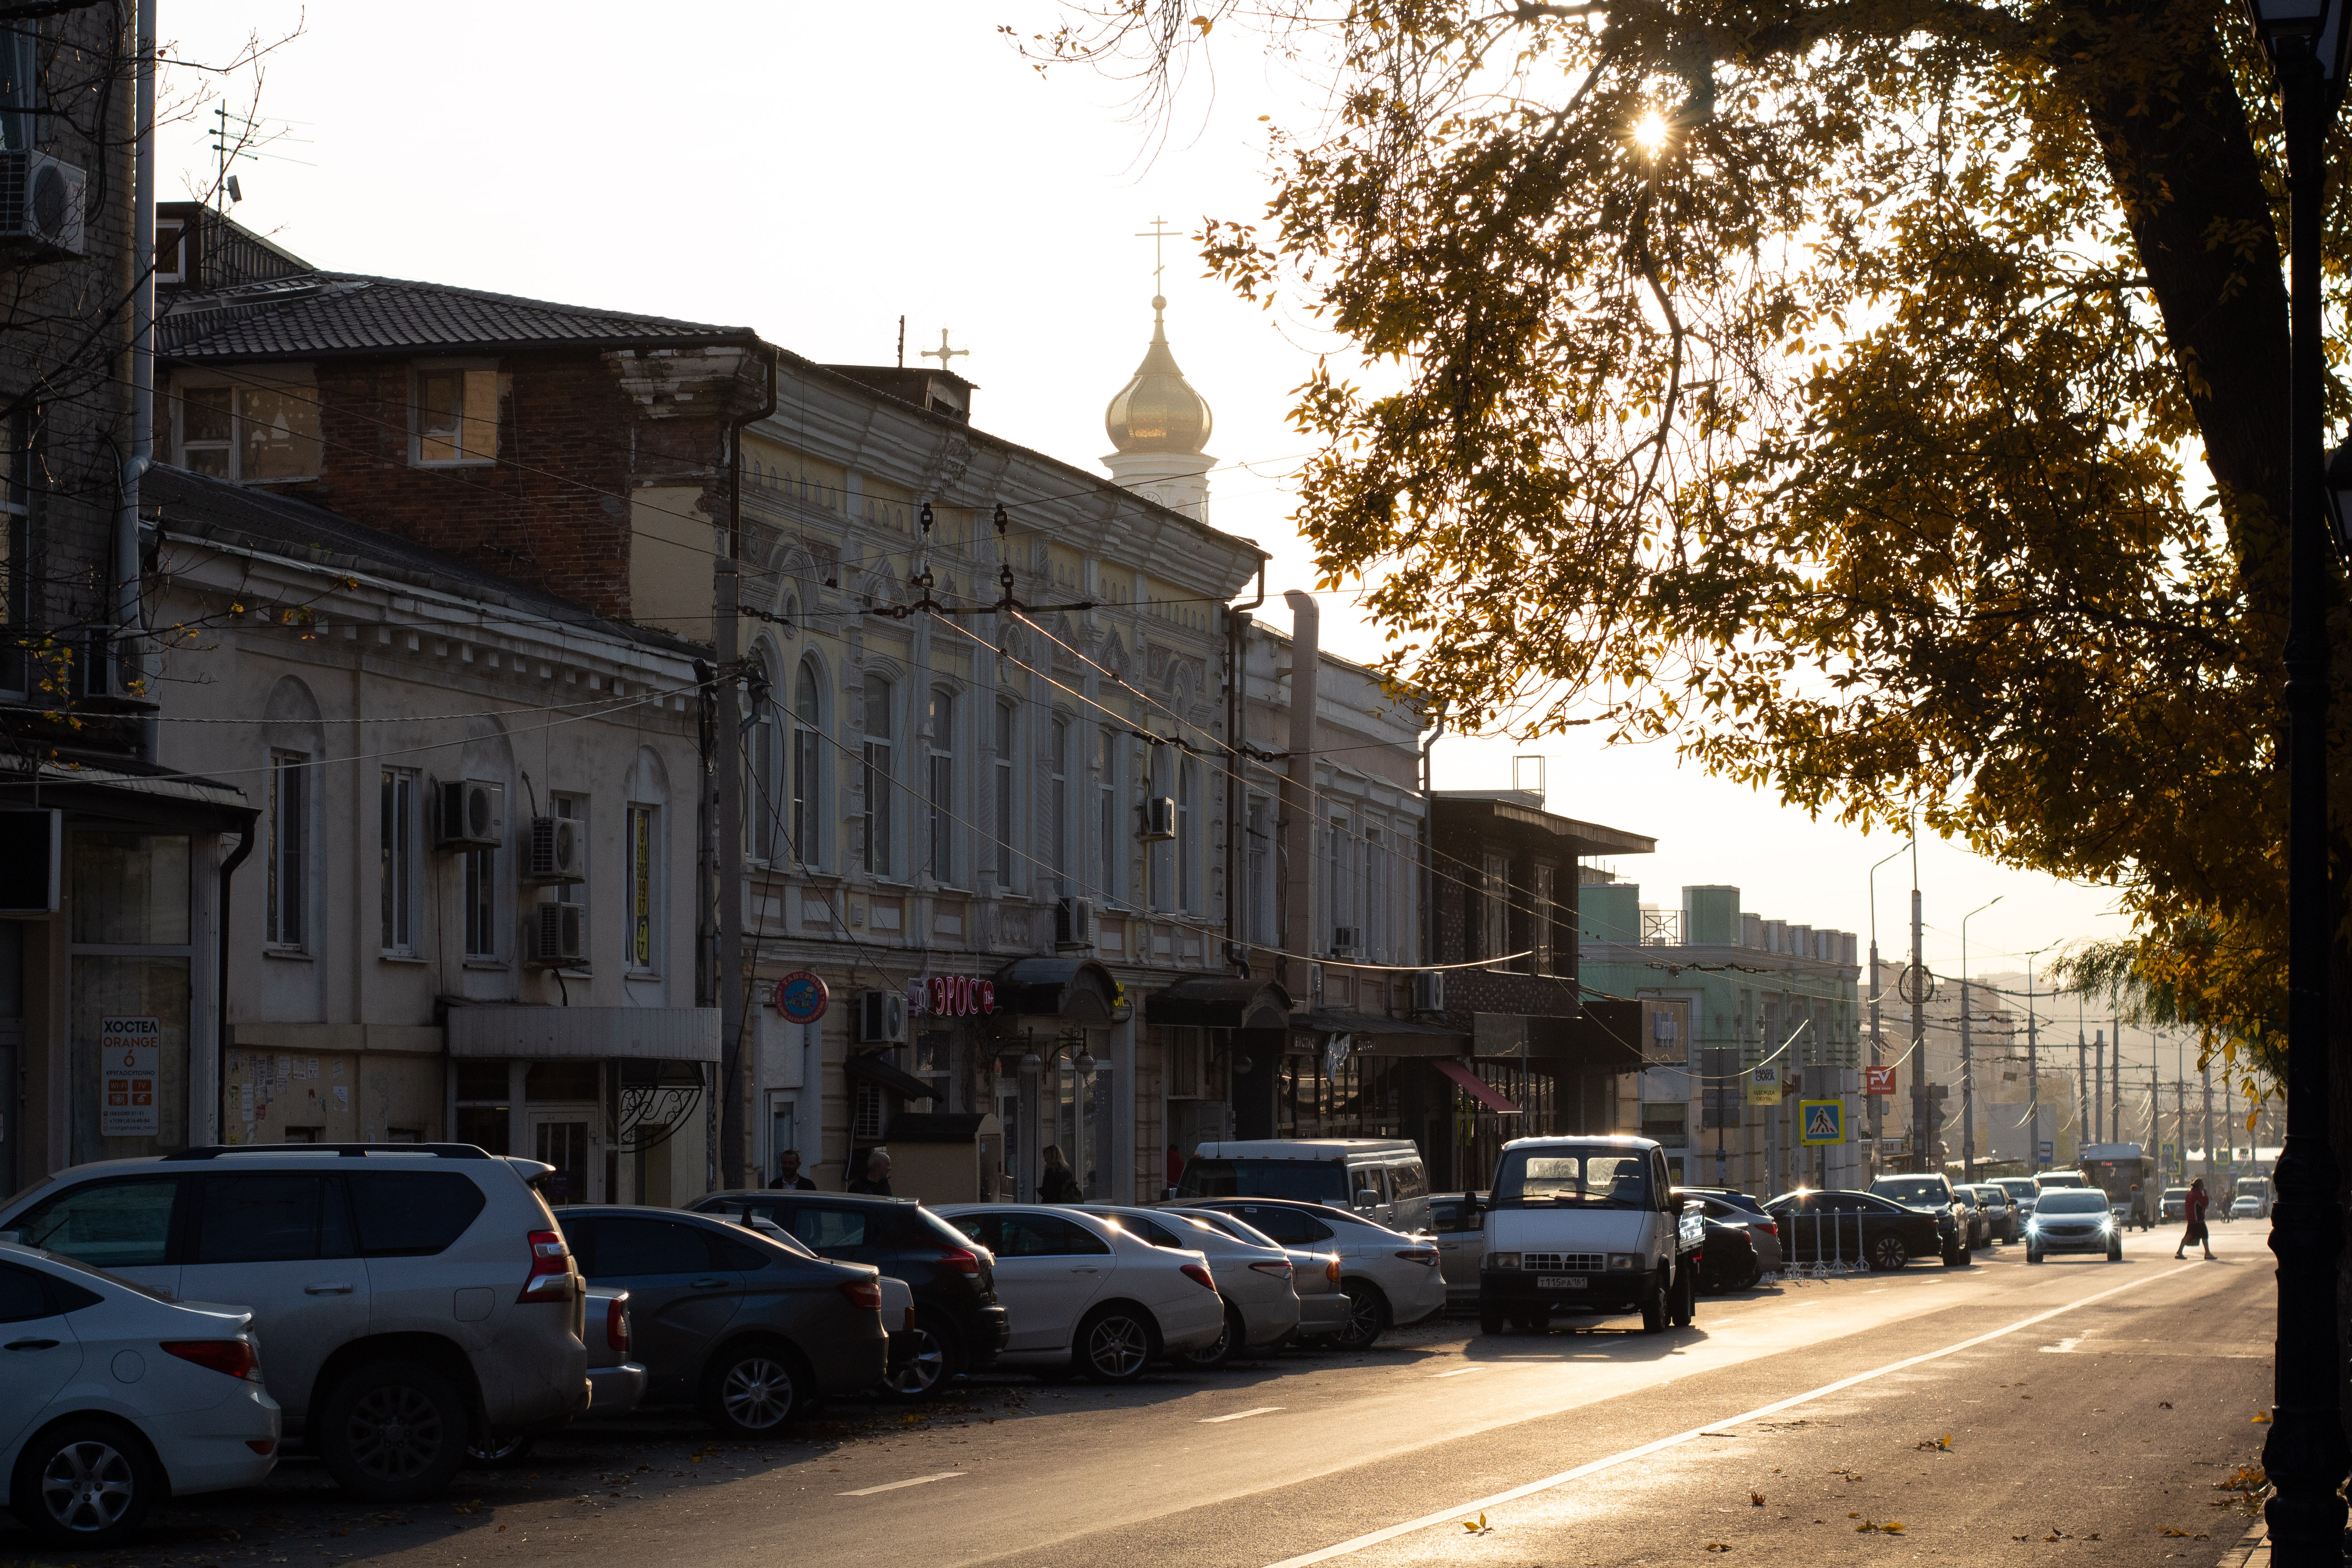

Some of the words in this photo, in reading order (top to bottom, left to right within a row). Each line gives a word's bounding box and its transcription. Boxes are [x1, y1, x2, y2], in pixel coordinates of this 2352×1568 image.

[777, 990, 789, 1018] МАГАЗИН
[813, 1001, 824, 1018] ОБУВИ
[936, 976, 978, 1016] ЭРОС
[984, 991, 994, 1005] 18+
[104, 1021, 157, 1033] ХОСТЕЛ
[103, 1037, 157, 1048] ORANGE
